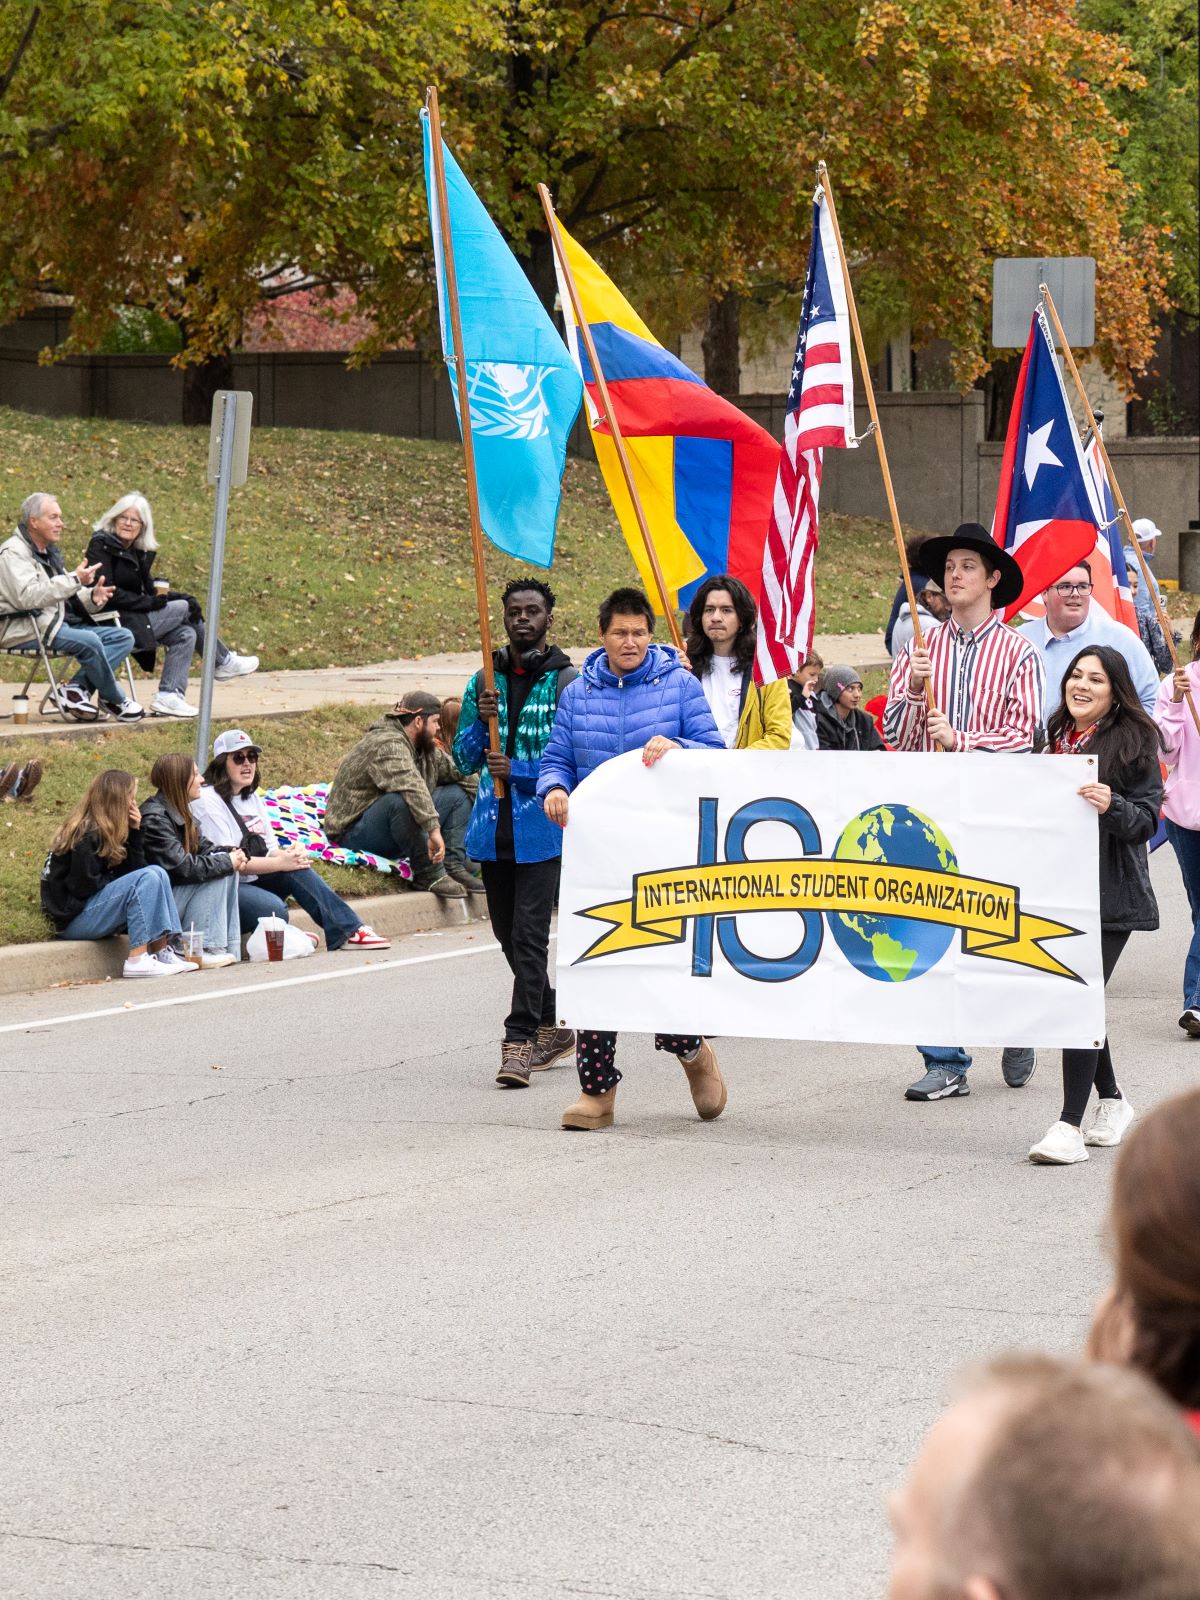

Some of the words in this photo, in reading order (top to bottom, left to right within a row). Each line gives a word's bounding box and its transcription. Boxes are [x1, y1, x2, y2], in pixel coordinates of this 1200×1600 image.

[644, 873, 784, 909] INTERNATIONAL
[790, 873, 869, 899] STUDENT
[874, 877, 1010, 921] ORGANIZATION
